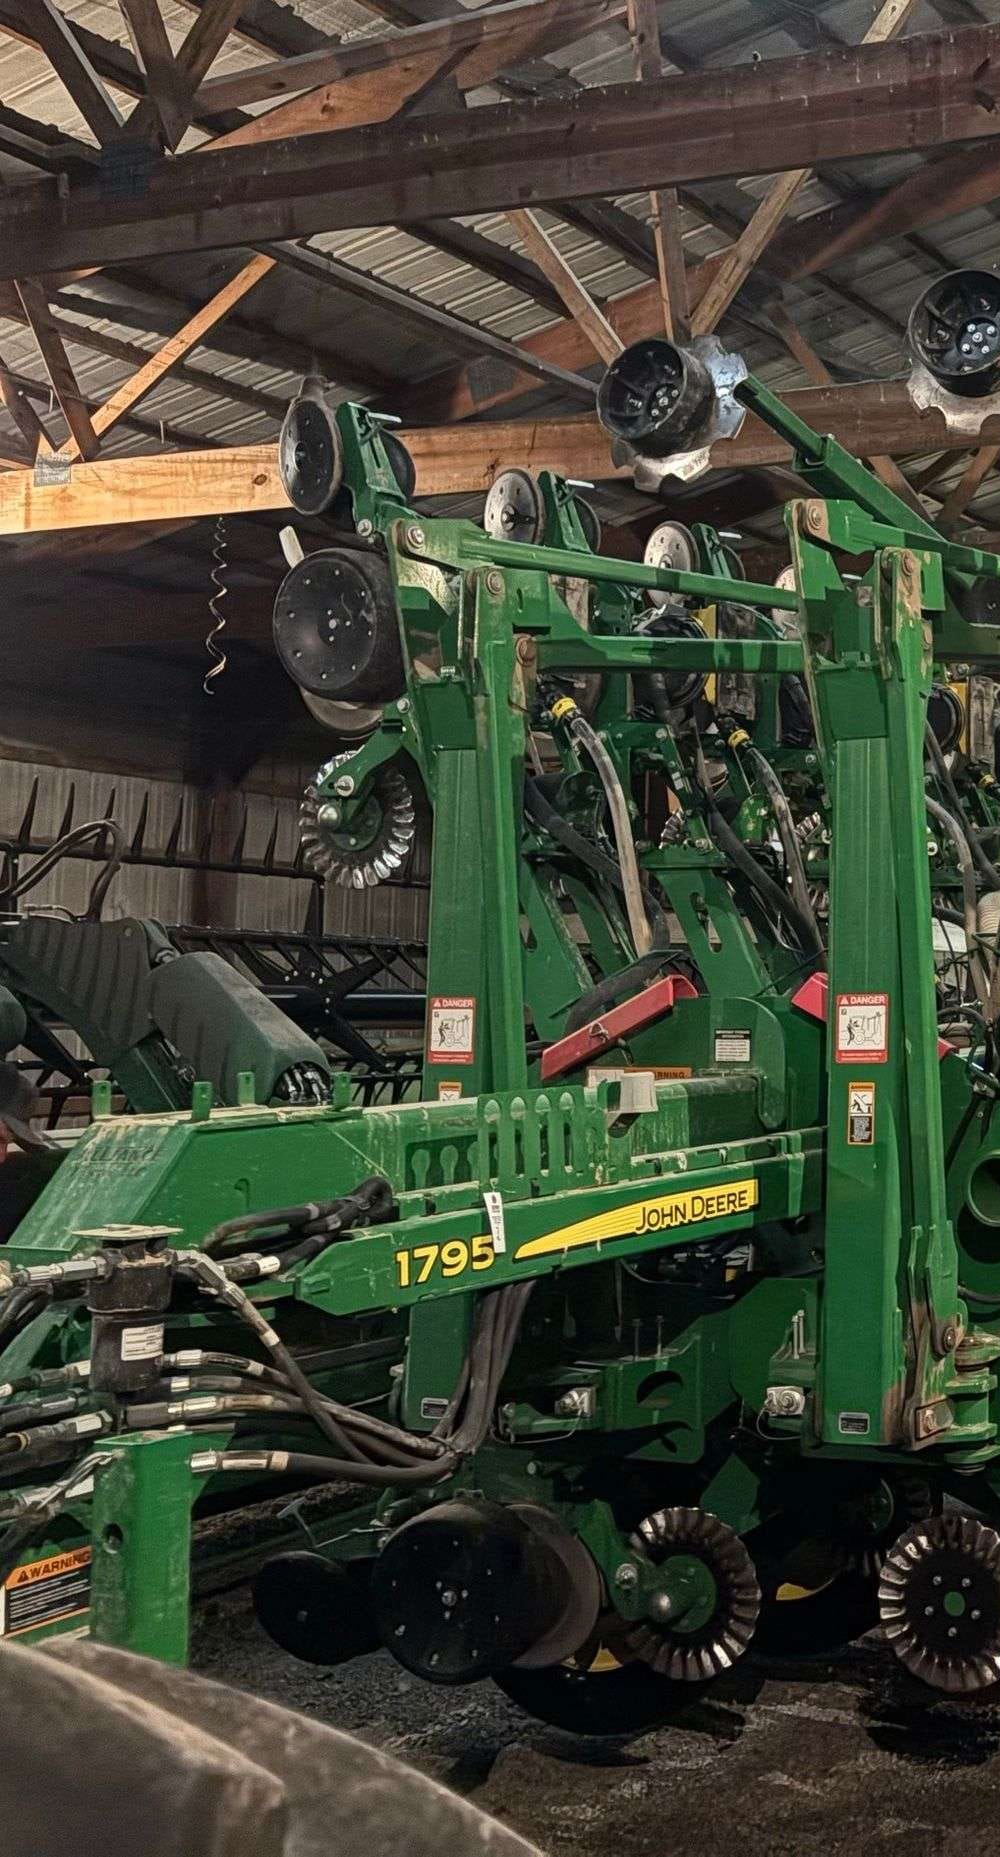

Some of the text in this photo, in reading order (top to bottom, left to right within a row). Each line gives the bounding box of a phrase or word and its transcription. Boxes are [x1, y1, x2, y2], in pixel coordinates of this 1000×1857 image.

[441, 999, 474, 1009] DANGER
[849, 995, 886, 1005] DANGER
[655, 1070, 687, 1080] RNING
[635, 1189, 749, 1232] JOHN DEERE
[395, 1233, 496, 1288] 1795
[29, 1549, 92, 1579] WARNING
